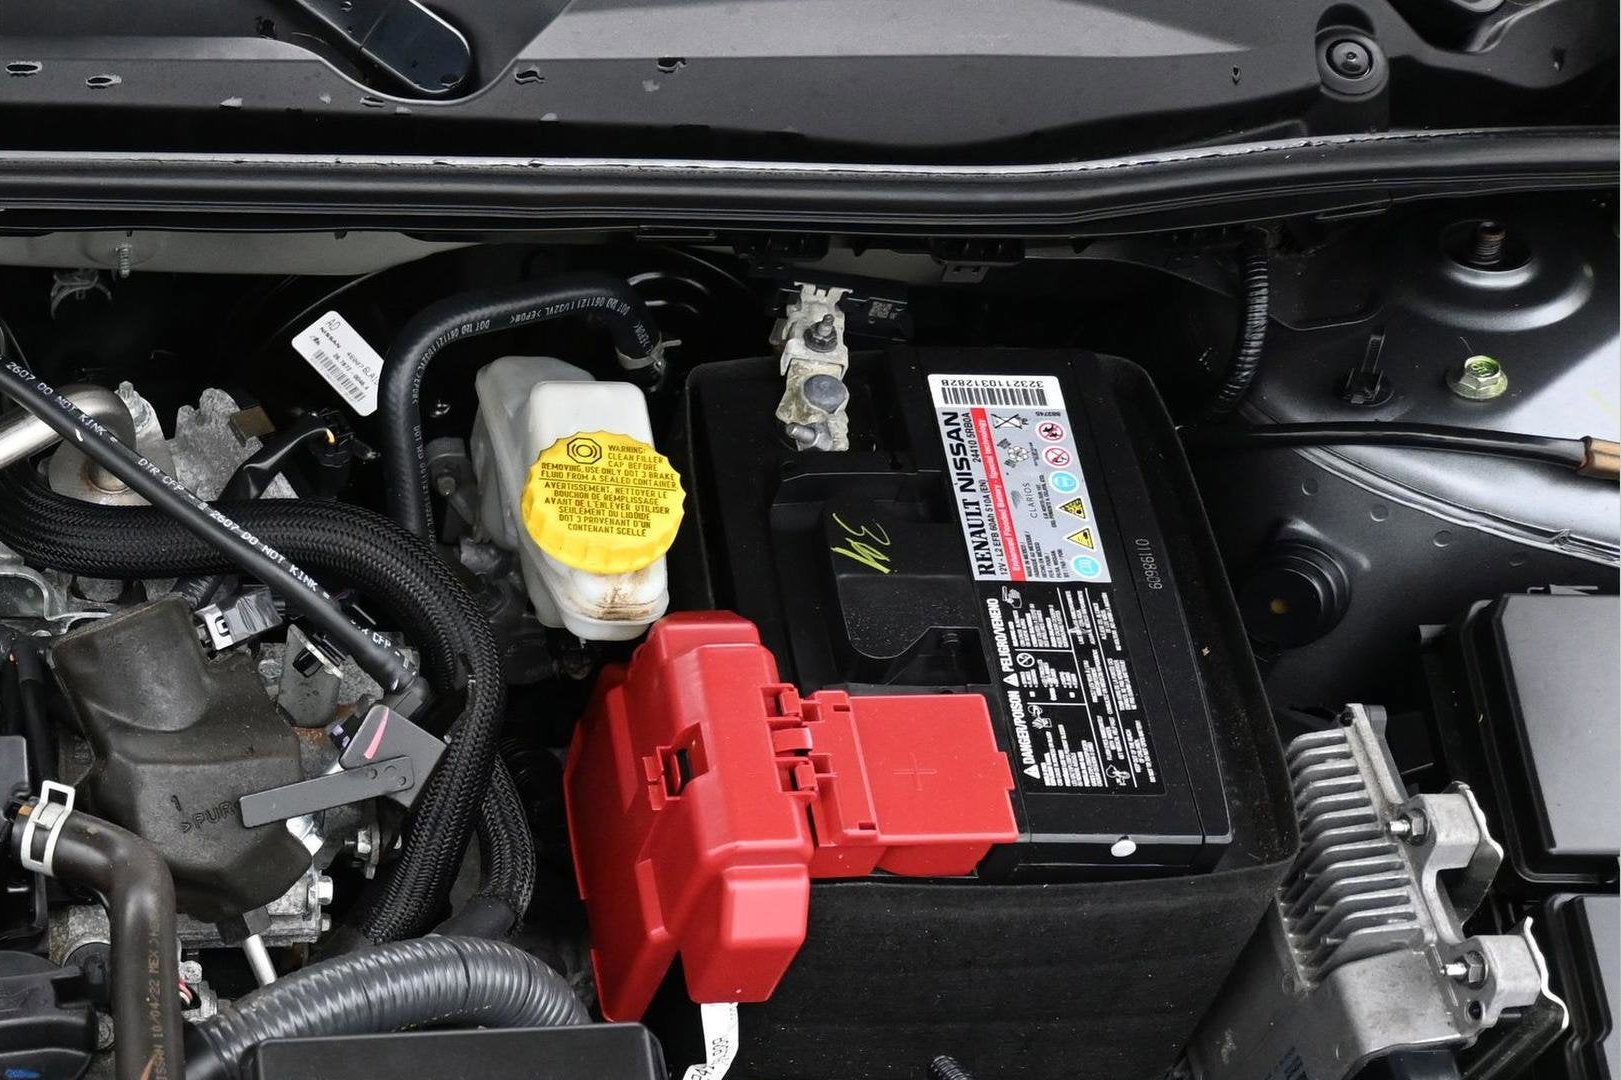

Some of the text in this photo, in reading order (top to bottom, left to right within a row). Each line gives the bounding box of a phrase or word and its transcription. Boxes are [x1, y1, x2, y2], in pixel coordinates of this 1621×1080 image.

[37, 382, 54, 395] DO
[56, 396, 78, 412] NOT
[80, 414, 107, 436] KINK
[608, 453, 663, 463] CLEAN FILLER
[967, 440, 981, 462] 24410
[628, 463, 657, 471] BEFORE
[649, 472, 675, 480] BRAKE
[940, 411, 996, 575] RENAULT NISSAN
[977, 479, 990, 492] (EN)
[554, 490, 589, 499] BOUCHON
[604, 494, 659, 505] REMPLISSAGE
[981, 494, 992, 511] 510A
[991, 484, 1005, 507] Battery
[1021, 482, 1038, 518] CLARIOS
[545, 497, 572, 505] AVANT
[635, 505, 670, 514] UTILISER
[559, 506, 605, 516] SEULEMENT
[559, 514, 574, 522] DOT
[584, 516, 630, 526] PROVENANT
[986, 513, 997, 530] 60Ah
[568, 523, 614, 534] CONTENANT
[990, 532, 1000, 545] EFB
[210, 510, 239, 531] 2607
[241, 531, 259, 545] DO
[262, 545, 286, 564] NOT
[289, 565, 318, 592] KINK
[993, 548, 1003, 556] L2
[1004, 537, 1019, 570] Enhanced
[997, 562, 1007, 574] 12V
[984, 597, 1037, 764] DANGER/POISON PELIGRO/VENENO
